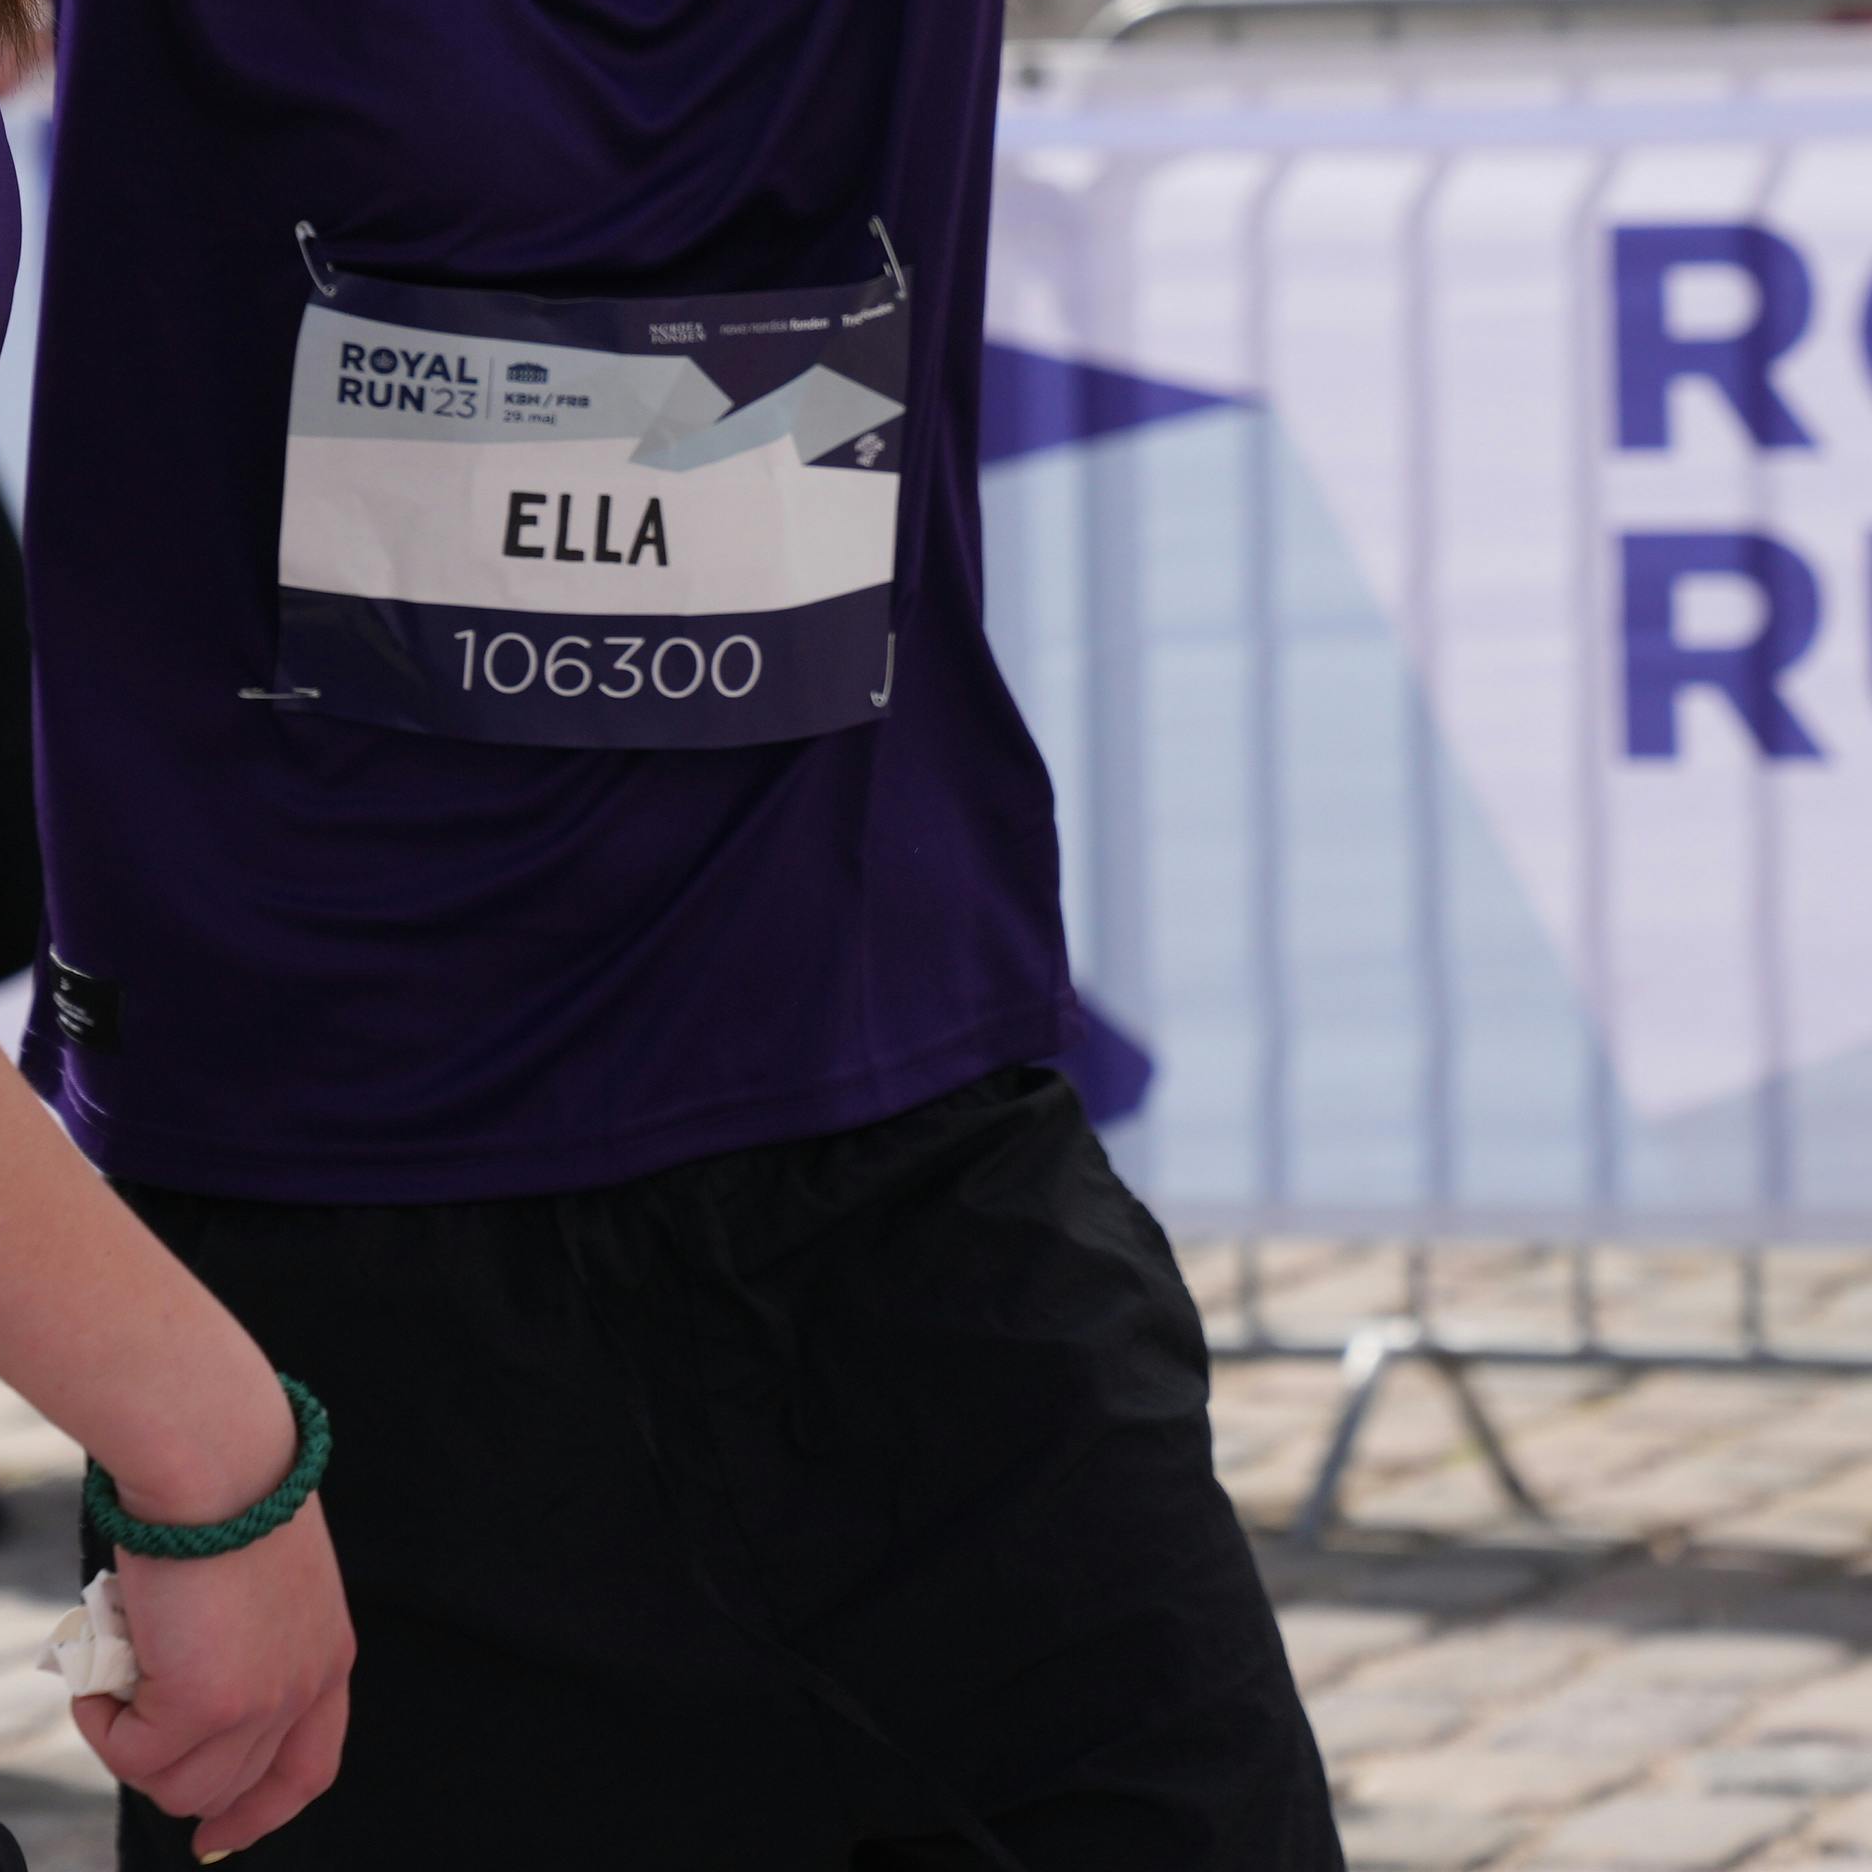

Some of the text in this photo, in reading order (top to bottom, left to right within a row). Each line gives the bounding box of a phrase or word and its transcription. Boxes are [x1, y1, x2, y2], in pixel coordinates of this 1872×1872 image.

[340, 342, 478, 385] ROYAL
[502, 490, 669, 567] ELLA
[453, 628, 763, 699] 106300
